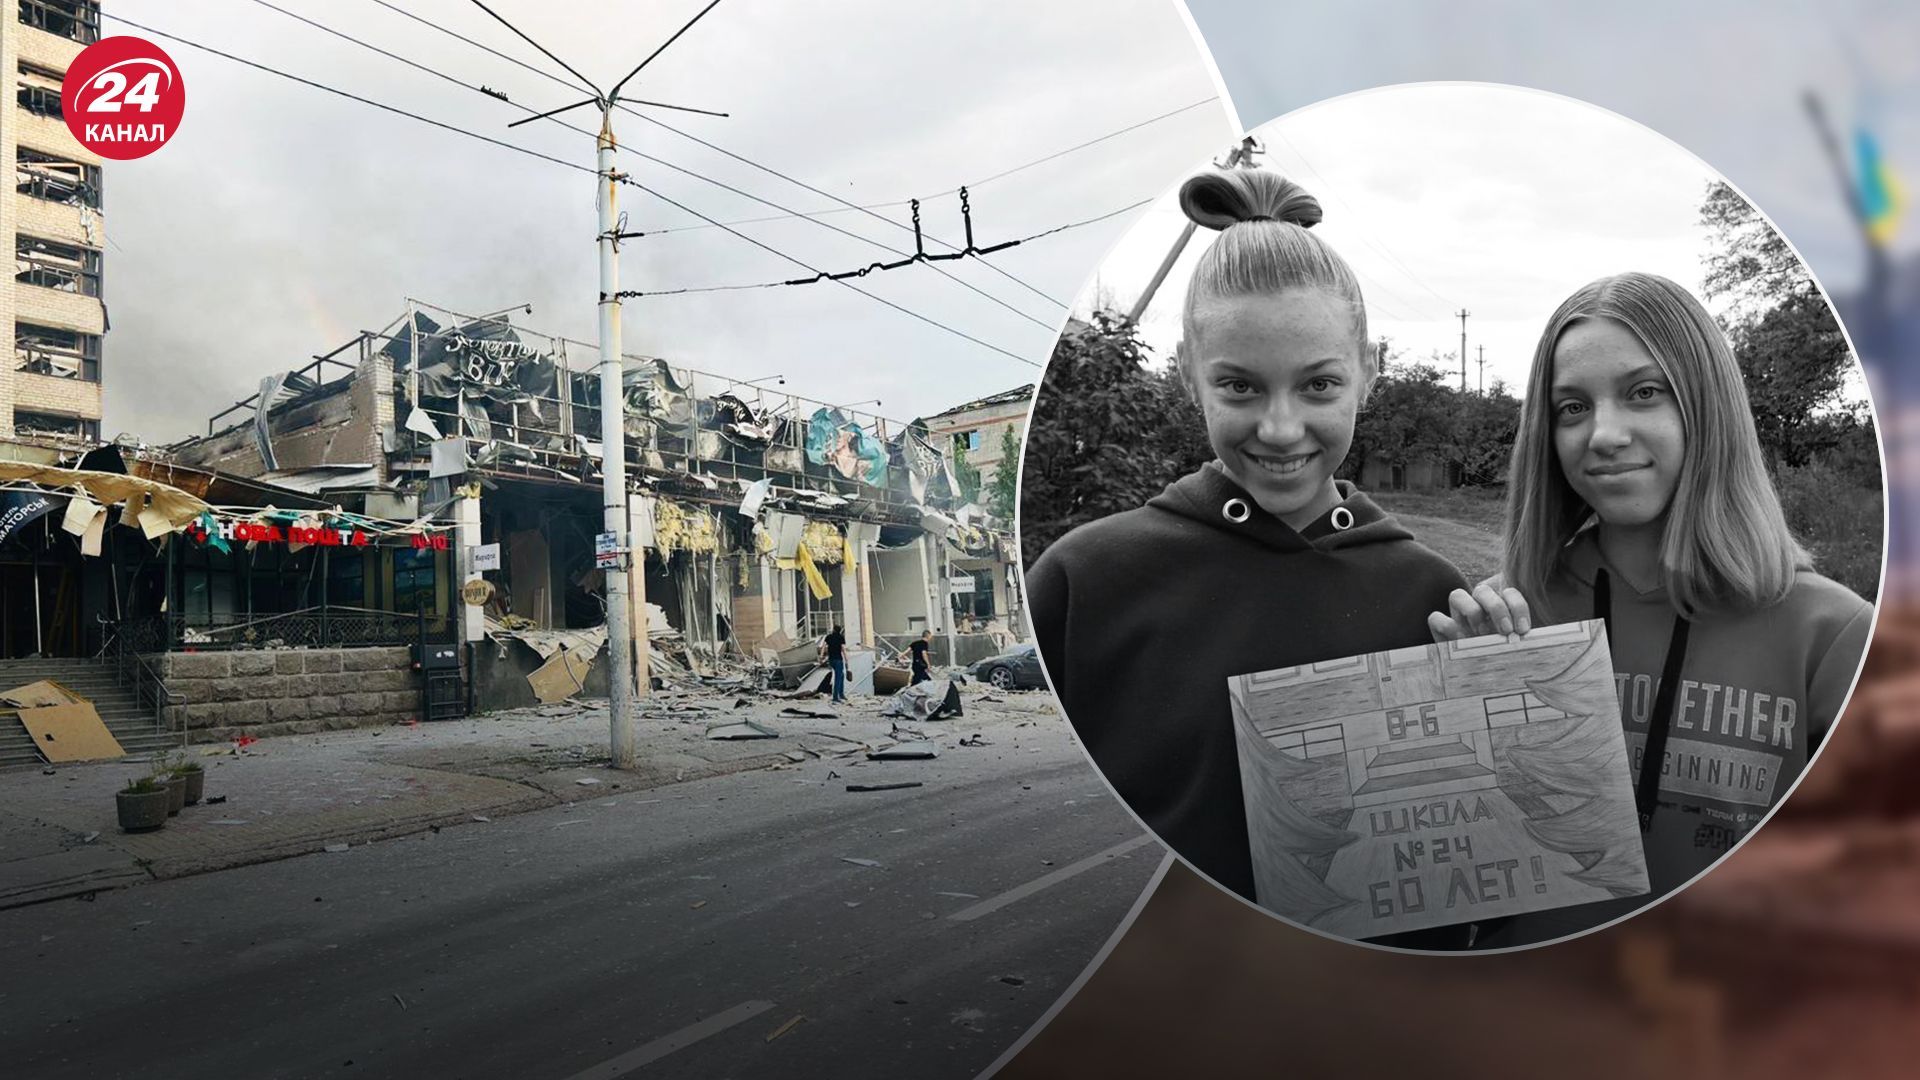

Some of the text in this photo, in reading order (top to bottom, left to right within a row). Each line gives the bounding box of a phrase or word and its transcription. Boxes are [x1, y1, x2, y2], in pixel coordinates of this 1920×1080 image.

[217, 521, 284, 543] НОВА
[287, 526, 369, 546] ПОШТА
[1614, 673, 1797, 750] TOETHER
[1634, 746, 1767, 792] BGINNING
[1370, 797, 1494, 837] ШКОЛА
[1368, 876, 1425, 919] 60
